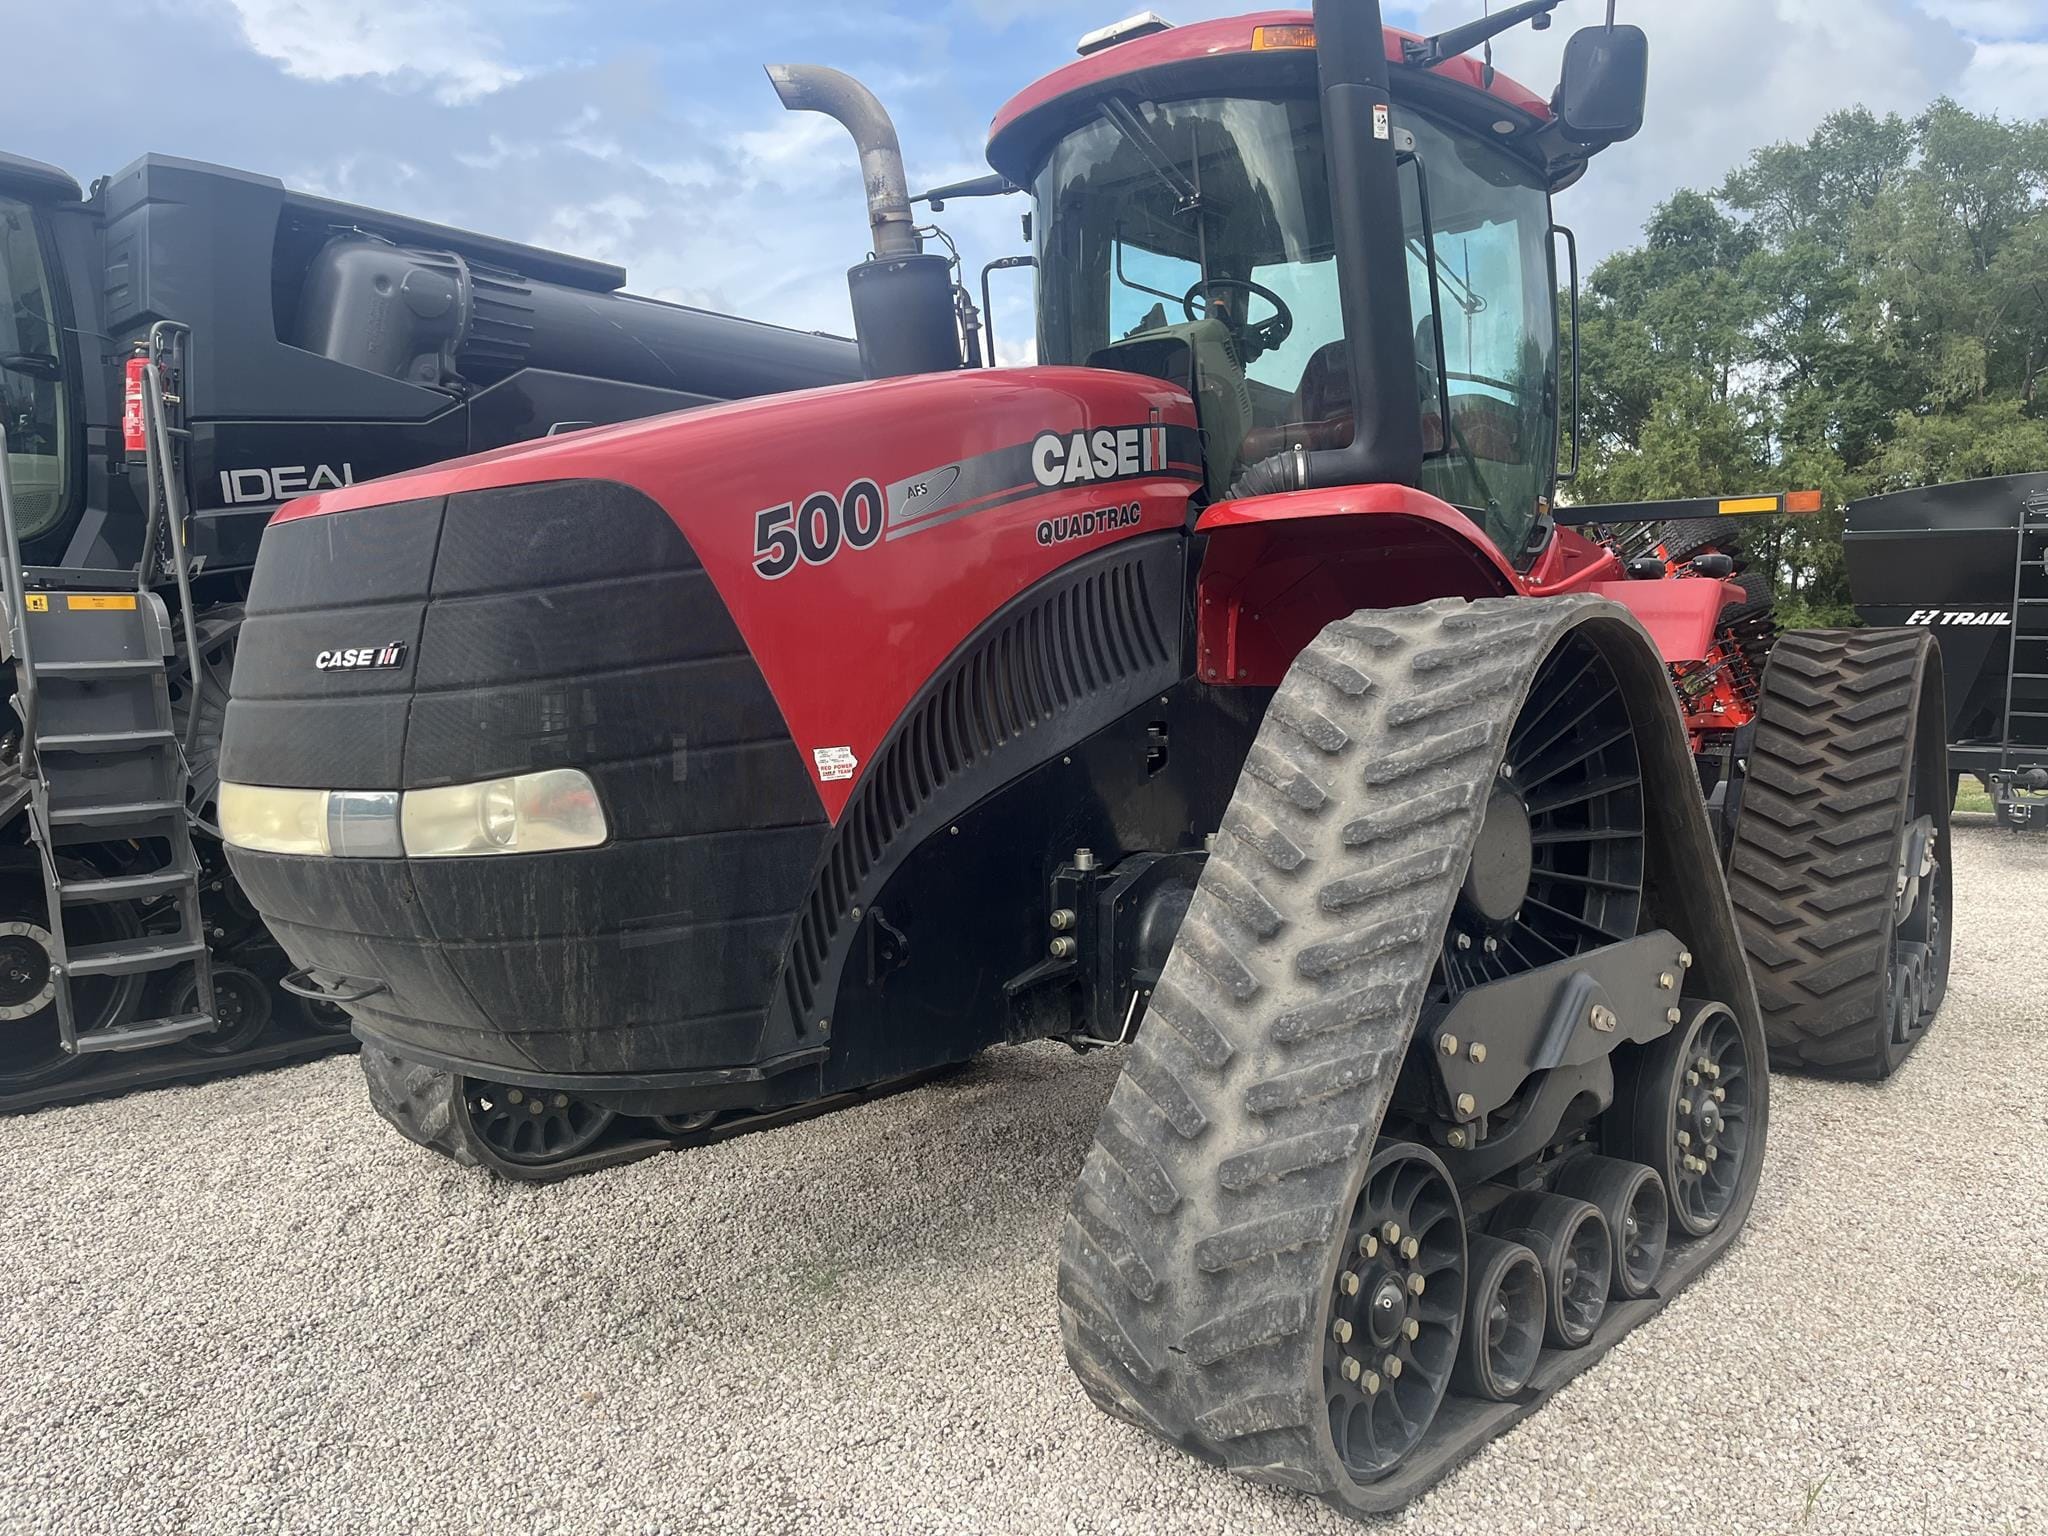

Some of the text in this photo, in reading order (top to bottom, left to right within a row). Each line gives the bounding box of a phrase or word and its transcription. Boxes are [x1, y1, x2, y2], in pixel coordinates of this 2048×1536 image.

[1031, 429, 1140, 487] CASE
[907, 482, 929, 499] AFS
[751, 477, 885, 580] 500
[1036, 501, 1142, 547] QUADTRAC
[1904, 609, 2013, 626] E-Z TRAIL
[315, 648, 375, 670] CASE
